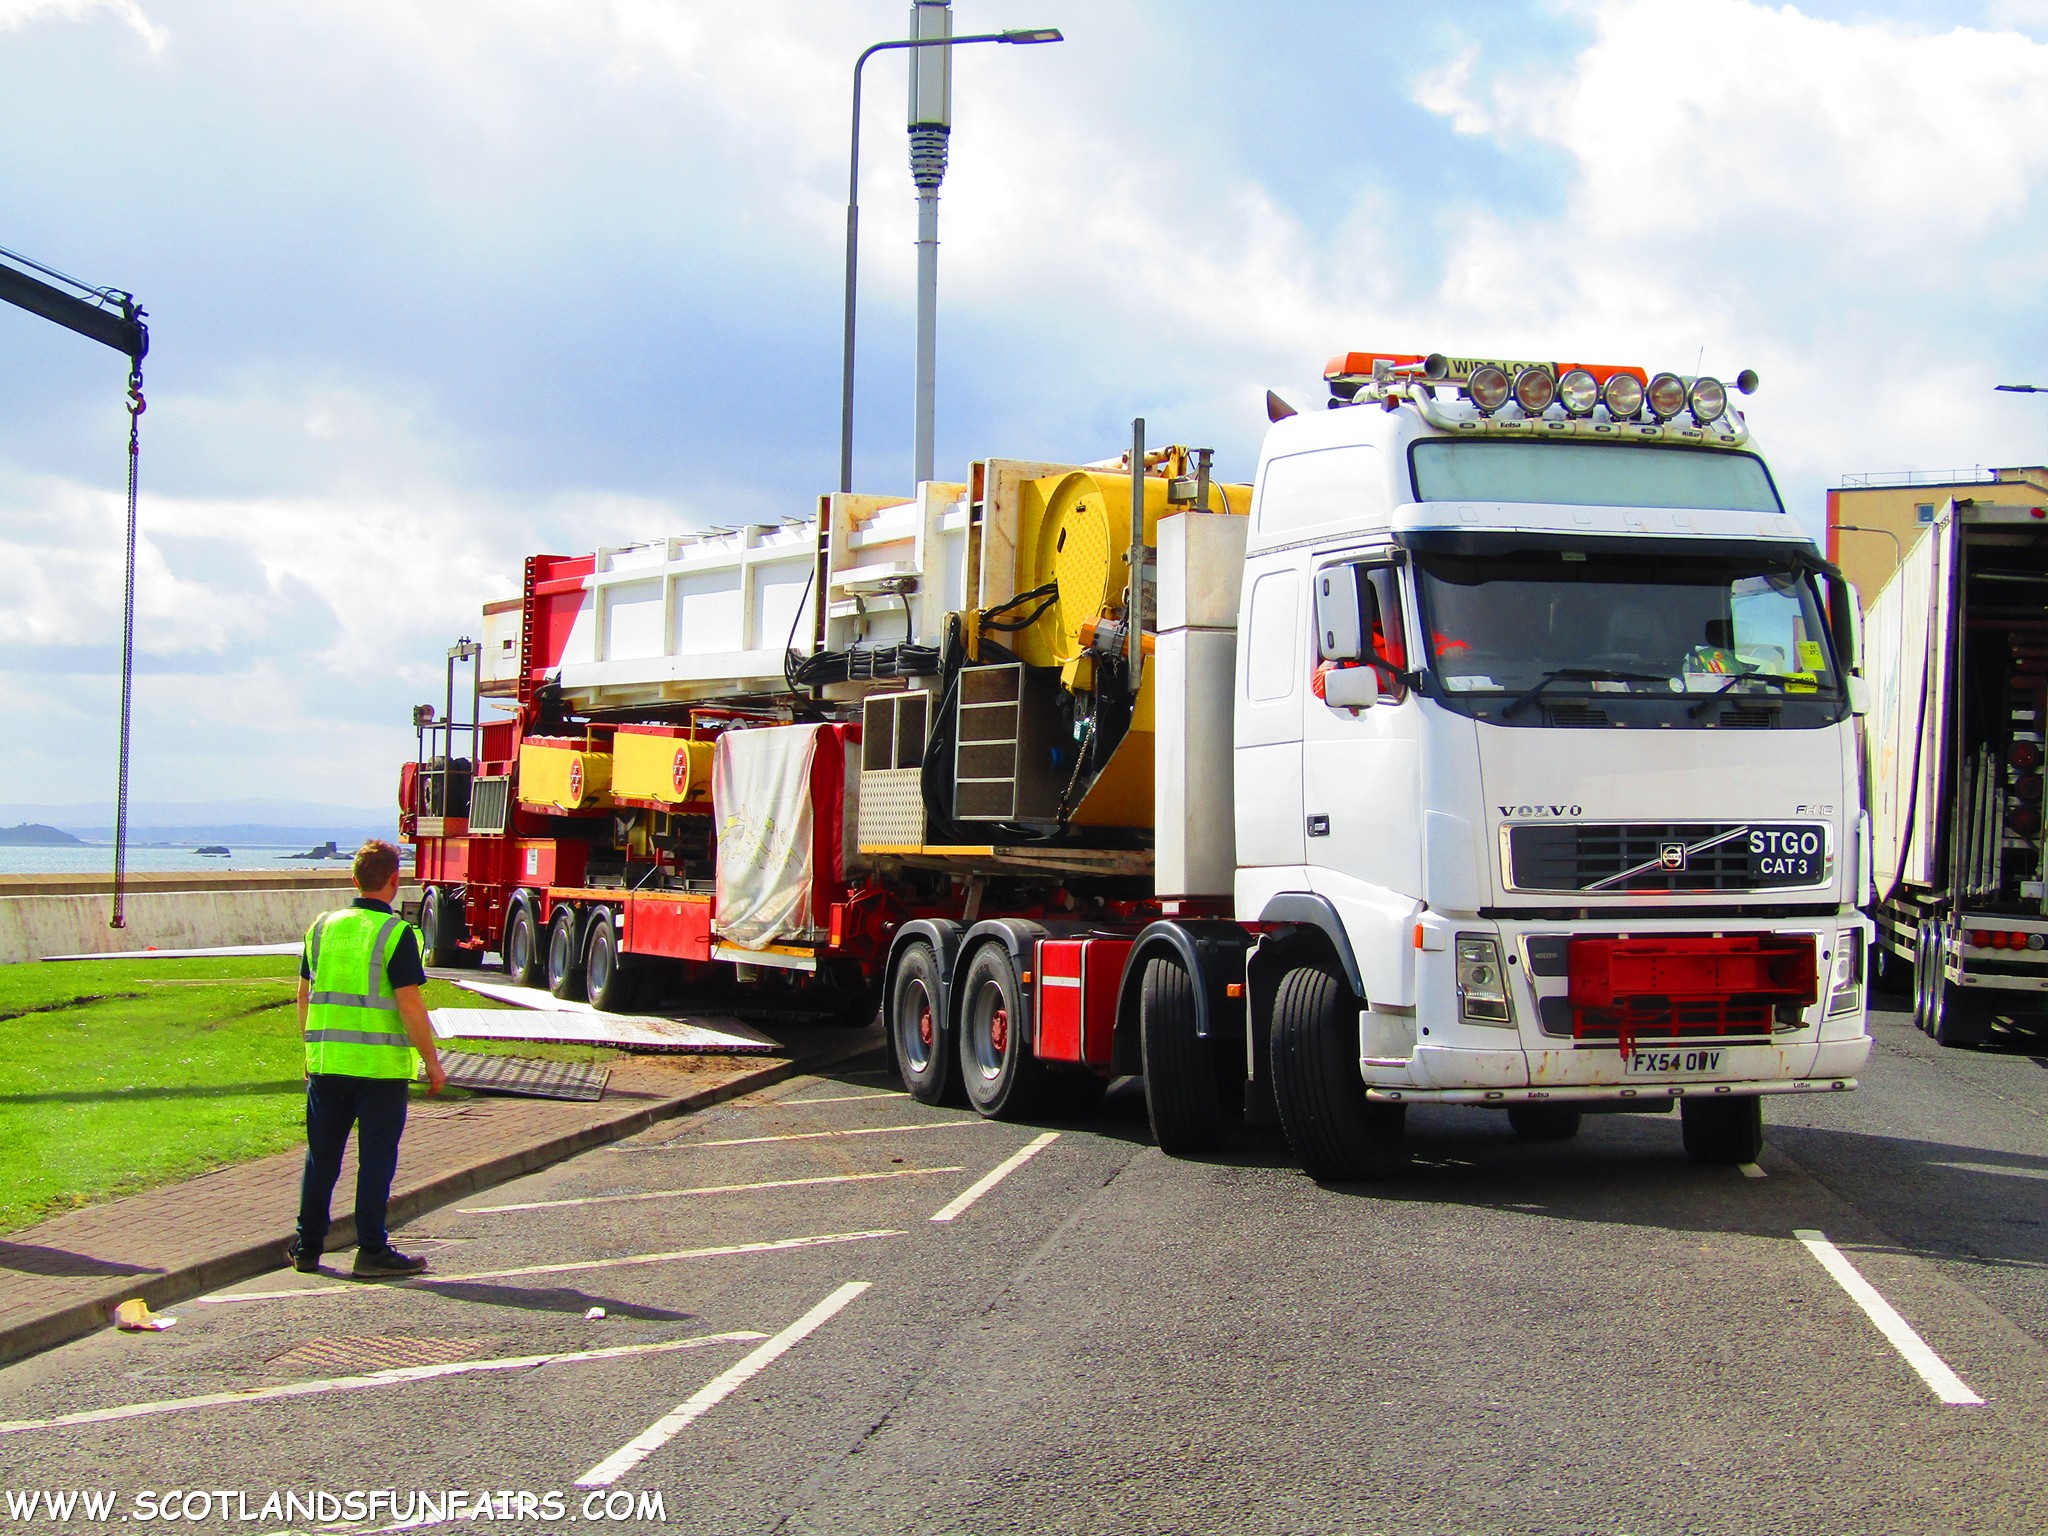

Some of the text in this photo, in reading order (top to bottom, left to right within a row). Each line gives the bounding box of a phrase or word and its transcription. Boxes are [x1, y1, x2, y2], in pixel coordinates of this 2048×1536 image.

[1453, 360, 1496, 373] WI
[1498, 805, 1582, 817] VOLVO
[1749, 831, 1818, 855] STGO
[1760, 858, 1808, 874] CAT 3
[1633, 1053, 1681, 1071] FX54
